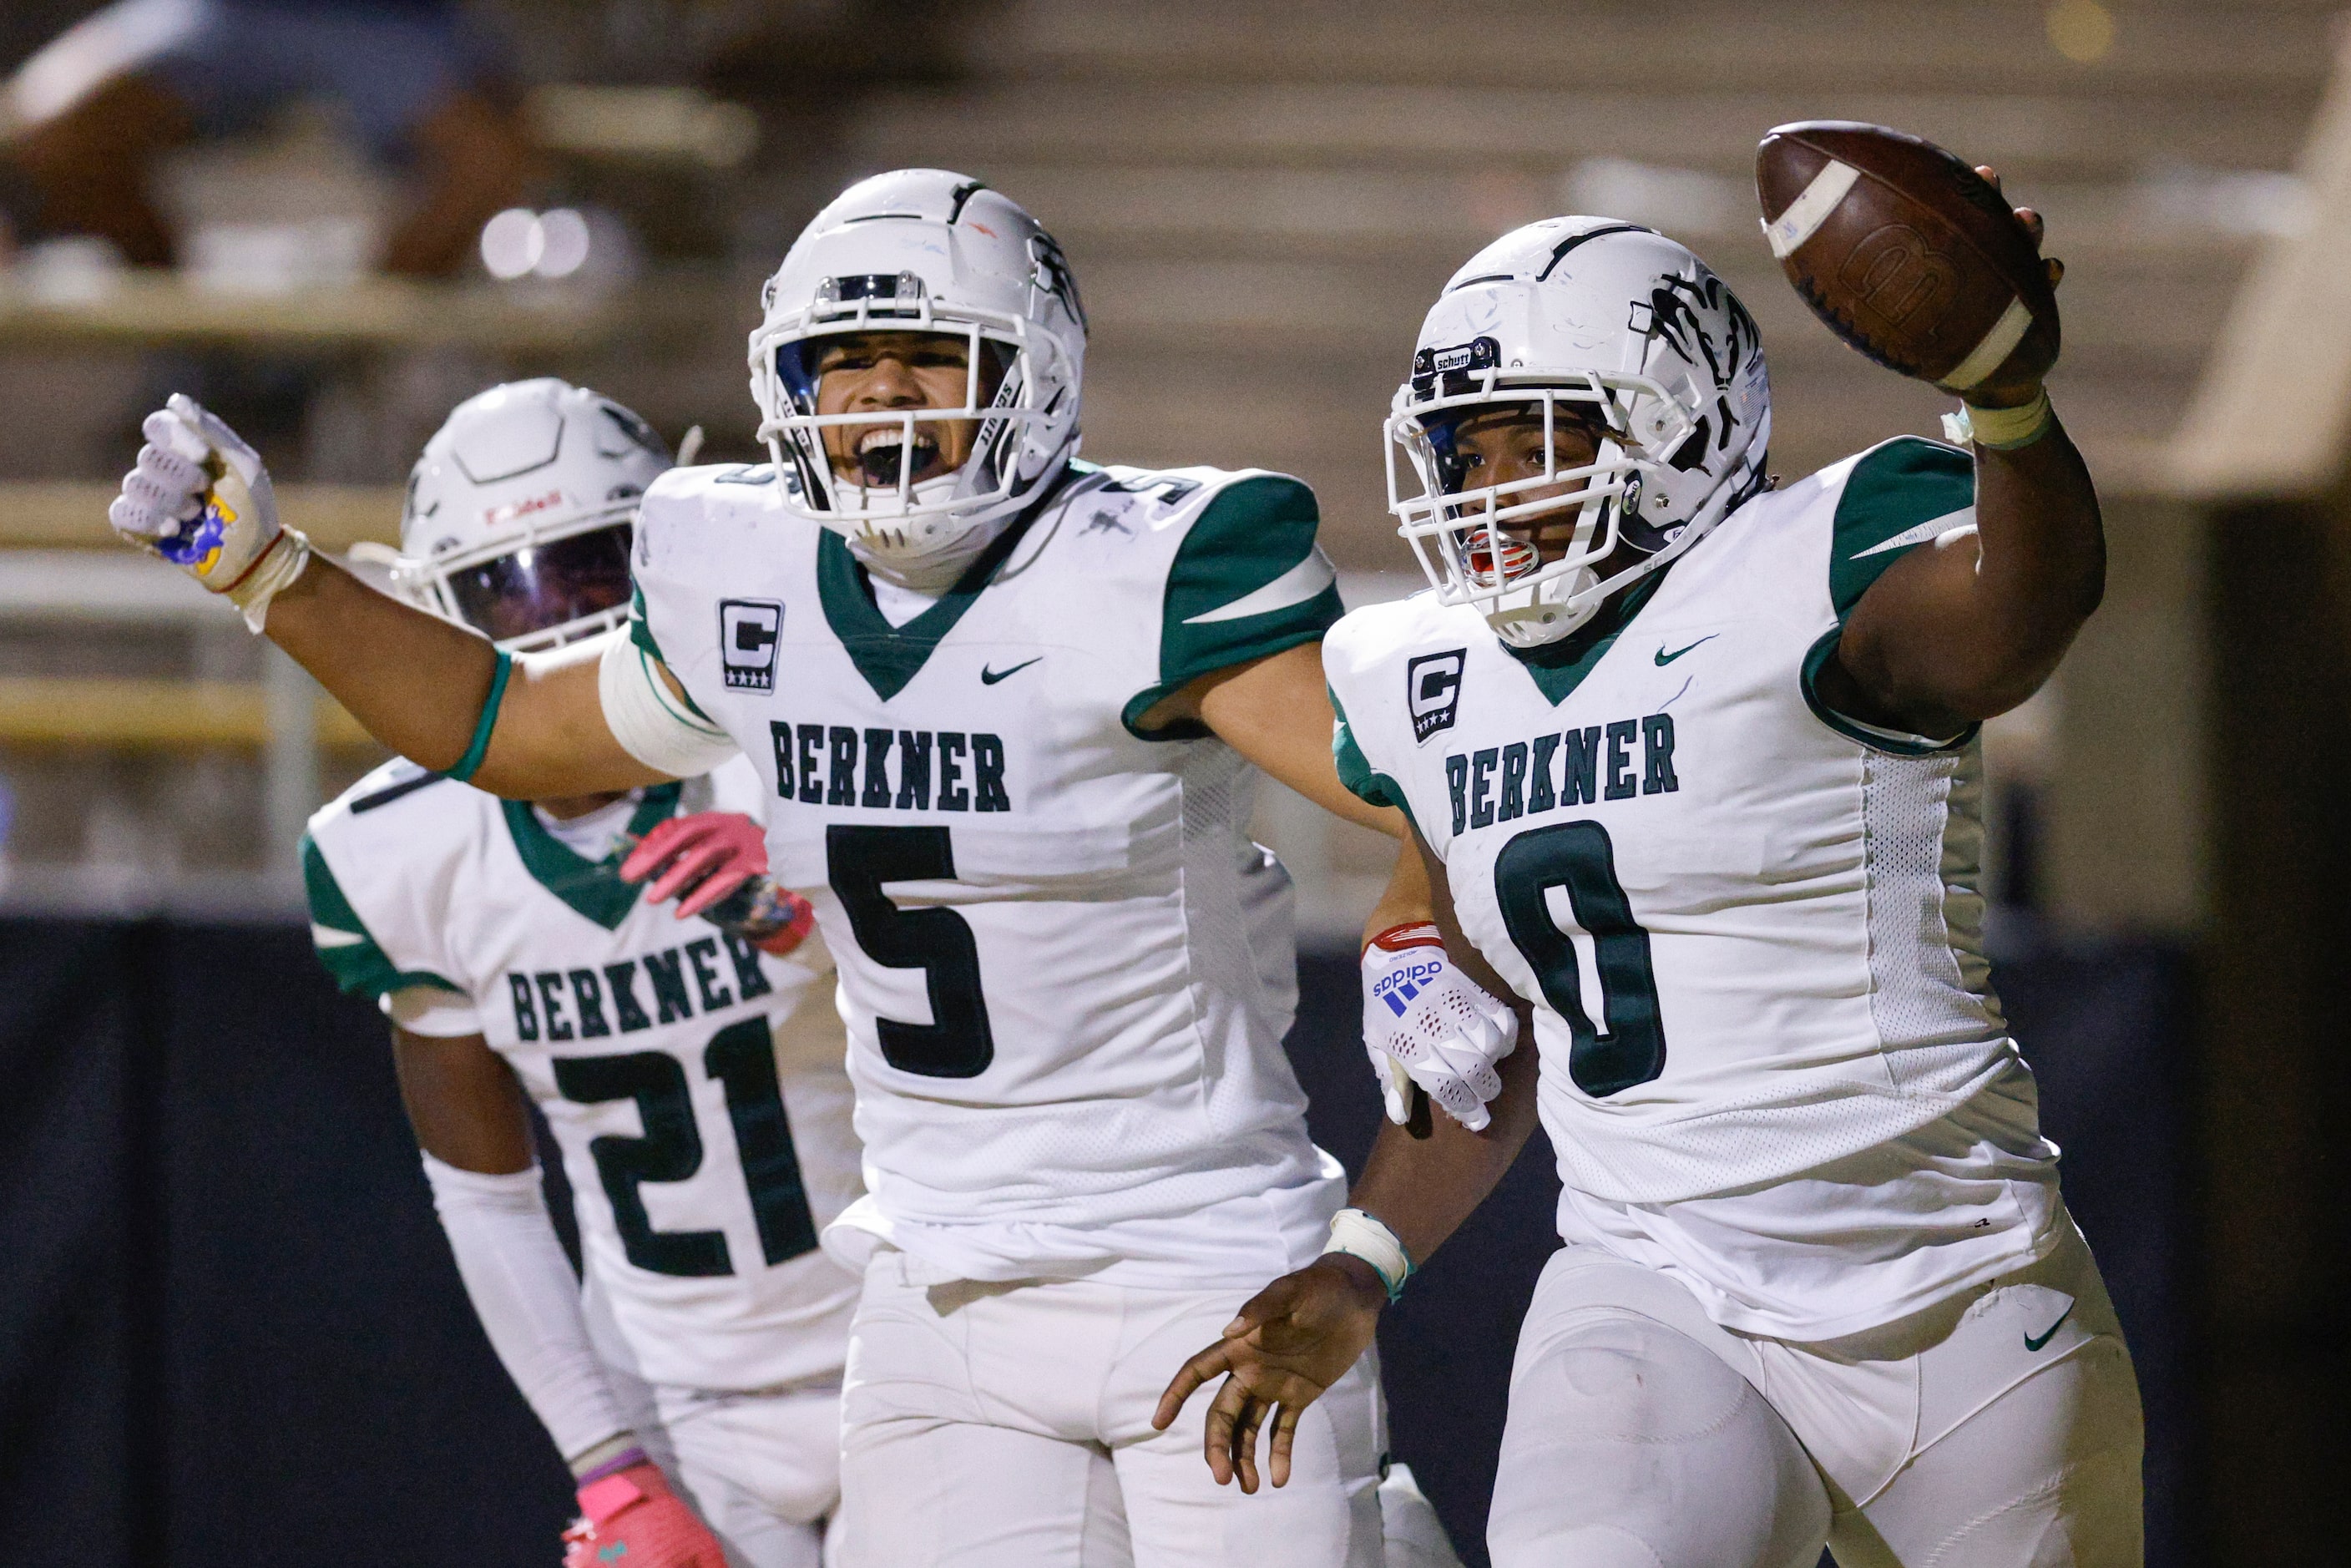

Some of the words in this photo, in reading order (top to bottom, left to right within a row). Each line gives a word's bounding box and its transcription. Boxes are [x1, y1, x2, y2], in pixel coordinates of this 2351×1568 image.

[1438, 354, 1469, 369] schutt
[724, 605, 777, 668] C
[1411, 655, 1460, 718] C
[770, 720, 1011, 812] BERKNER
[1446, 712, 1679, 837] BERKNER
[507, 928, 772, 1041] BERKNER
[826, 824, 994, 1079] 5
[1373, 961, 1443, 997] adidas
[1494, 819, 1667, 1099] 0
[551, 1014, 820, 1277] 21
